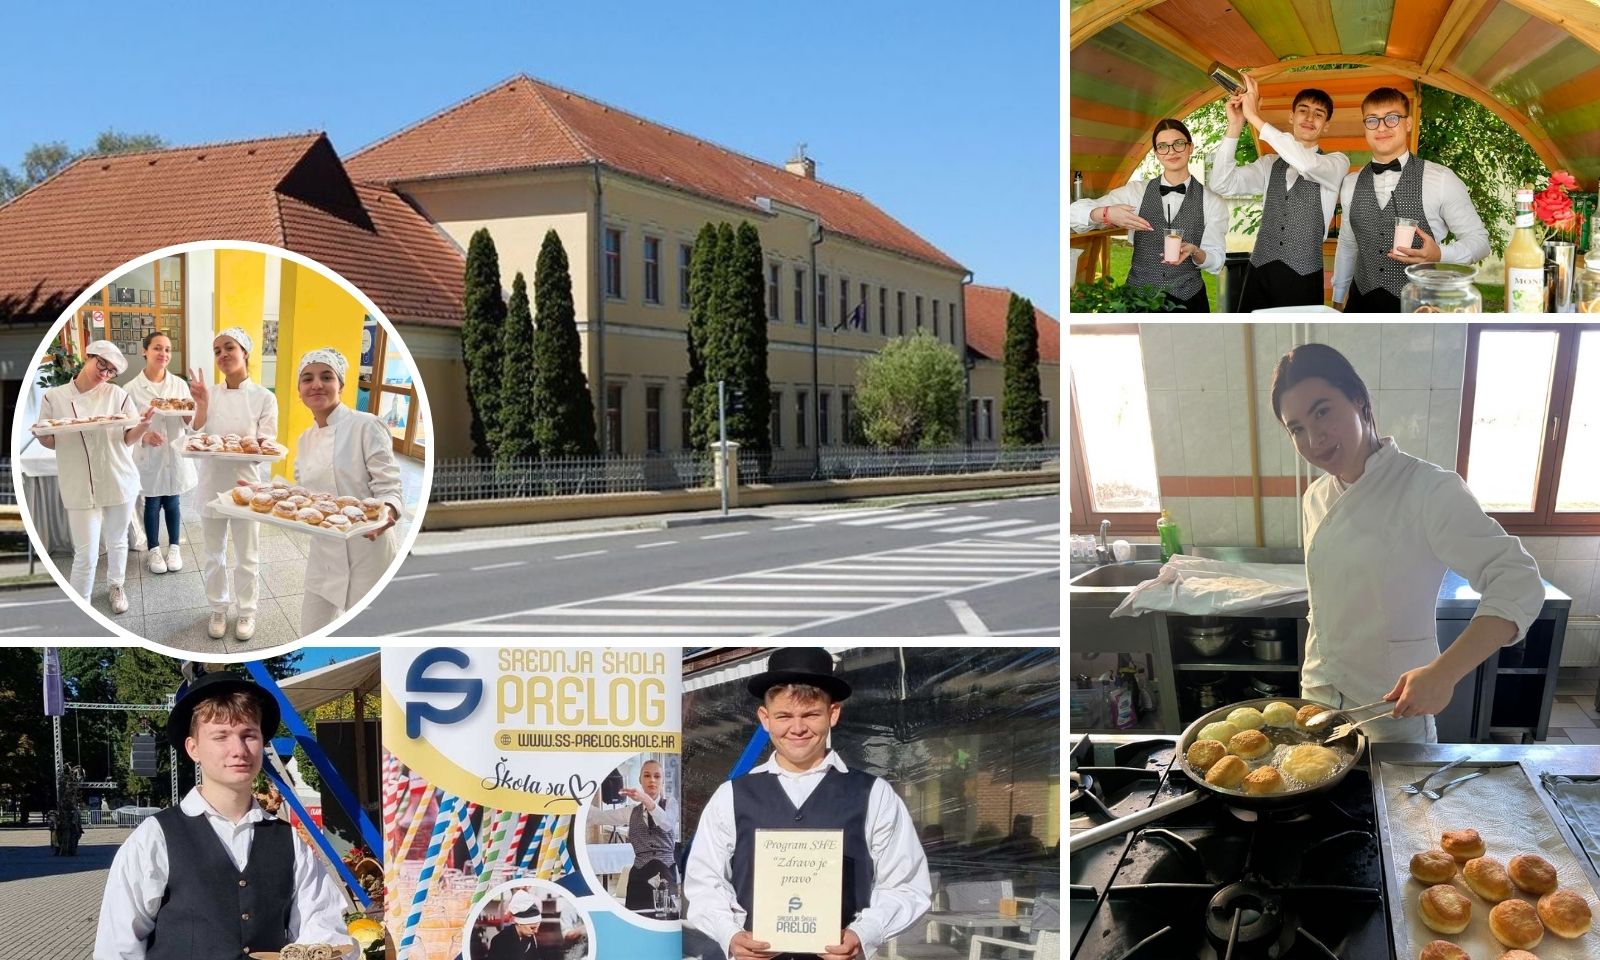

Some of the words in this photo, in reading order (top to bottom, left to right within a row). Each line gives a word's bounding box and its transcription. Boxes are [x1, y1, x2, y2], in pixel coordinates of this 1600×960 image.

[498, 648, 593, 674] SREDNJA
[602, 647, 665, 675] ŠKOLA
[496, 674, 665, 727] PRELOG
[517, 733, 675, 749] WWW.SS-PRELOG.SKOLE.HR
[481, 756, 542, 794] Škola
[545, 782, 566, 796] sa
[764, 839, 807, 853] Program
[809, 839, 837, 850] SHE
[816, 858, 828, 871] je
[776, 921, 817, 934] PRELOG
